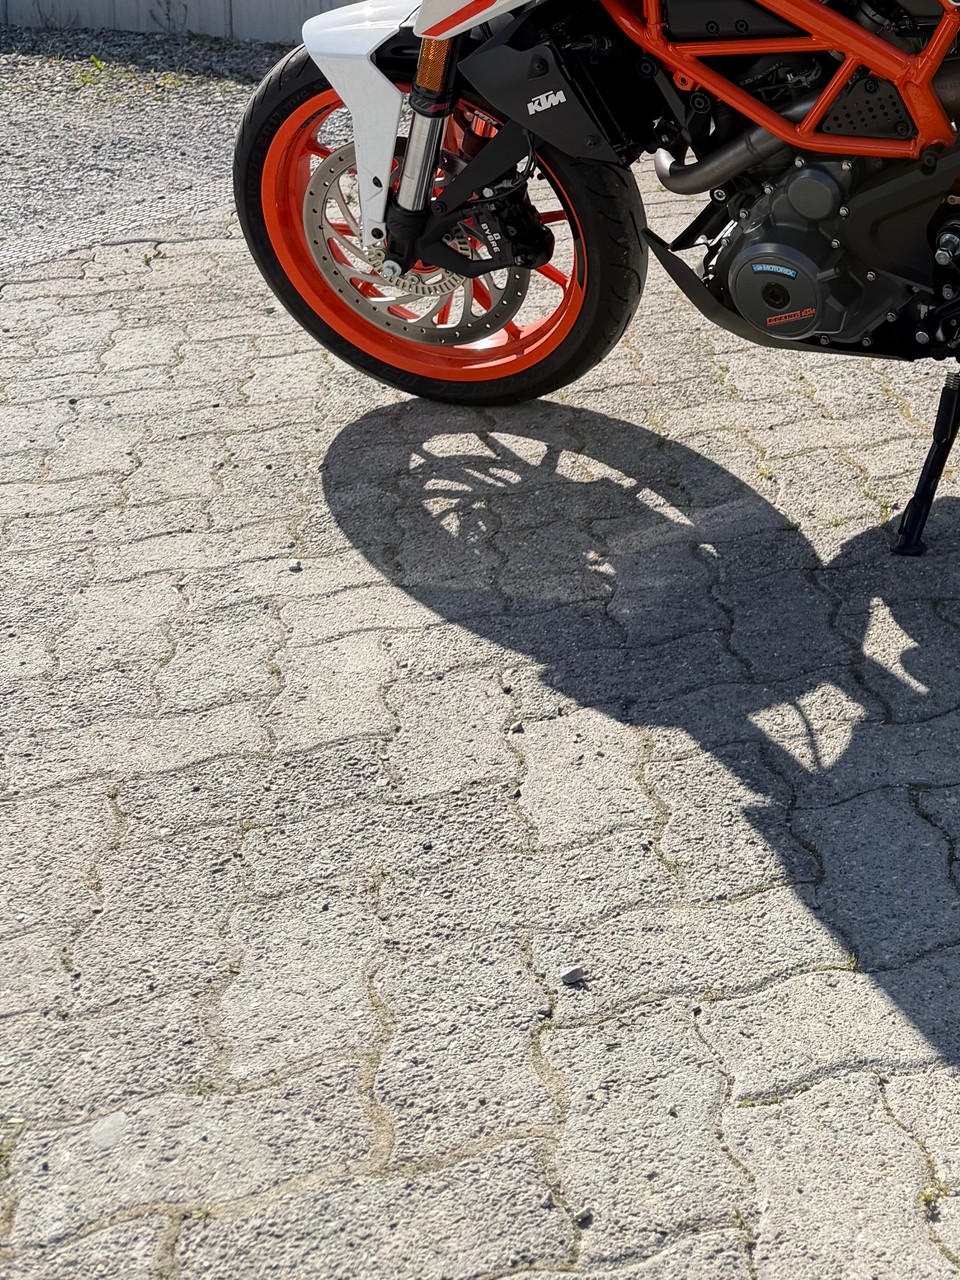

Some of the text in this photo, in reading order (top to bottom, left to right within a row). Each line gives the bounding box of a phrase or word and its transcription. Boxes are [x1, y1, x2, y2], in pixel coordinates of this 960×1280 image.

[527, 90, 567, 116] KTM
[481, 222, 500, 253] BYBRE
[763, 264, 797, 278] MOTOREX
